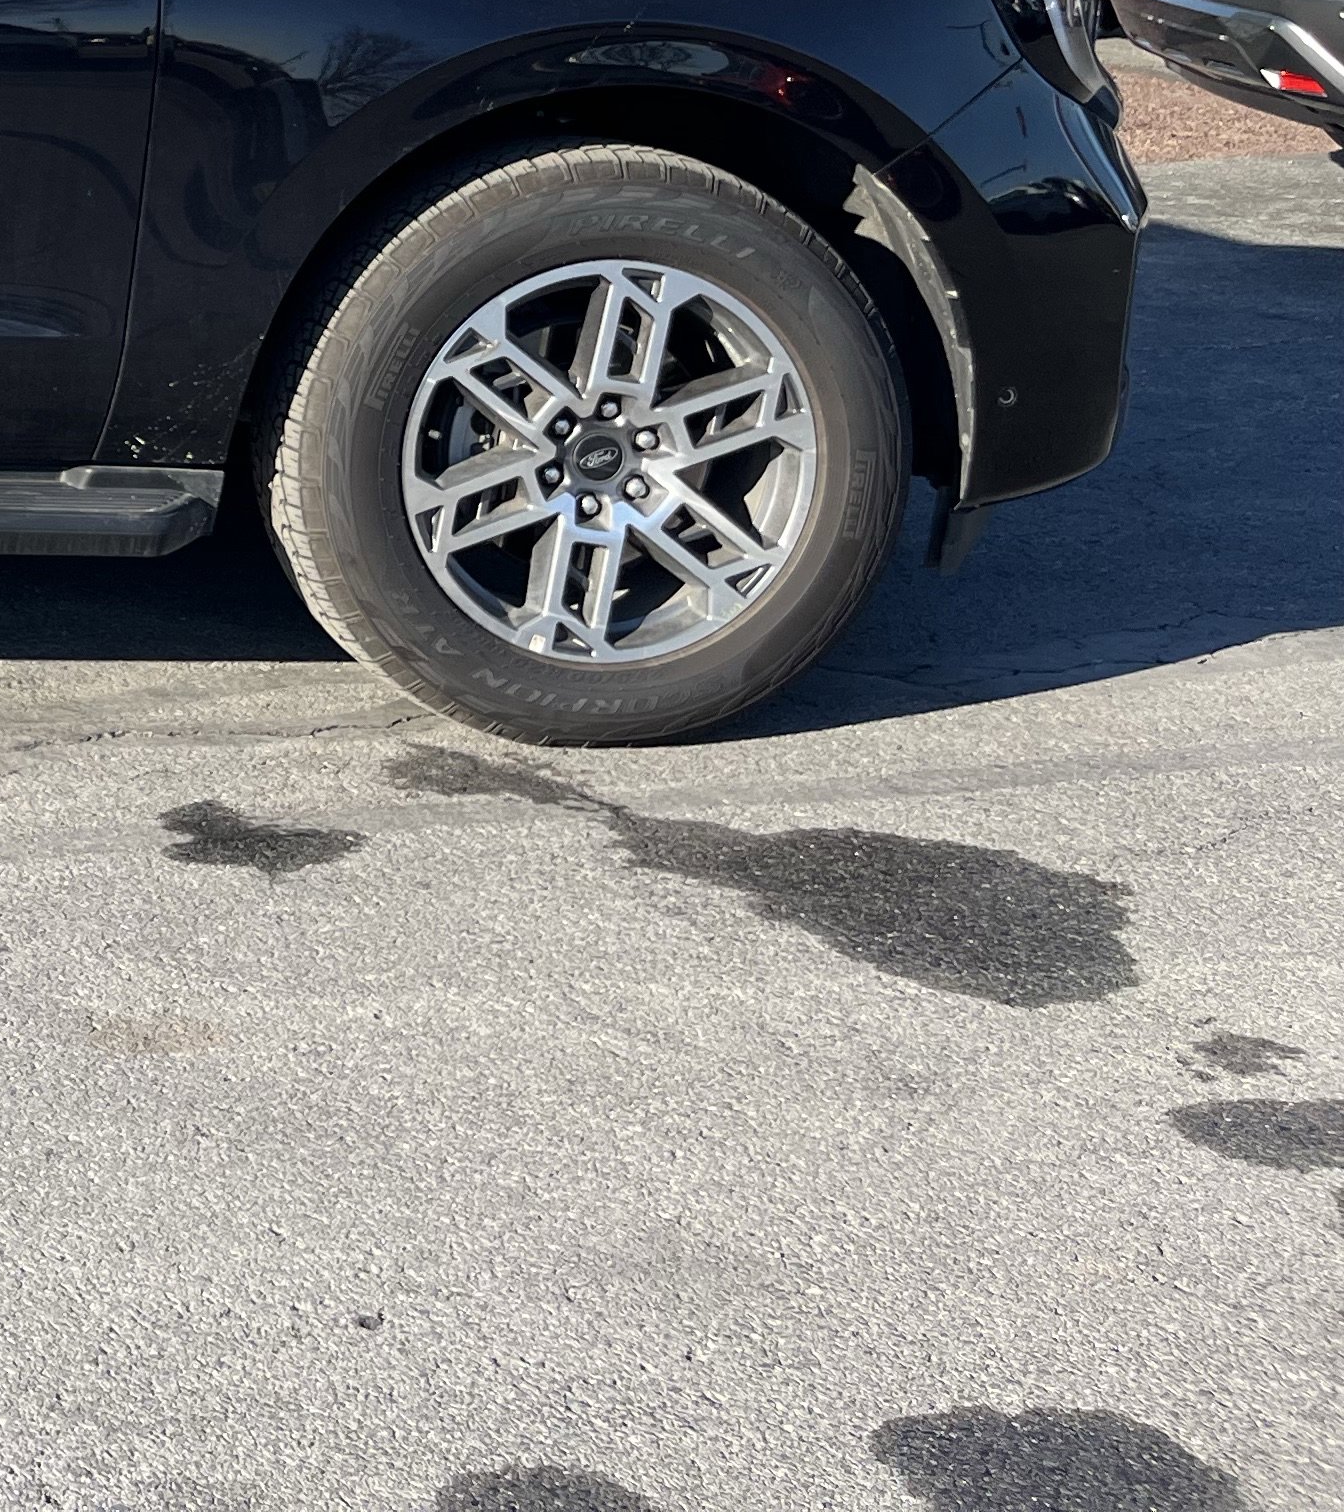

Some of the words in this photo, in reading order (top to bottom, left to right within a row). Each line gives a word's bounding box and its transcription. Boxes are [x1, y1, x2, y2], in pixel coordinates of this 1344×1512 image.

[572, 215, 756, 260] PIRELLI
[363, 327, 420, 411] PIRELLI
[584, 448, 615, 468] Ford
[842, 448, 877, 540] PIRELLI
